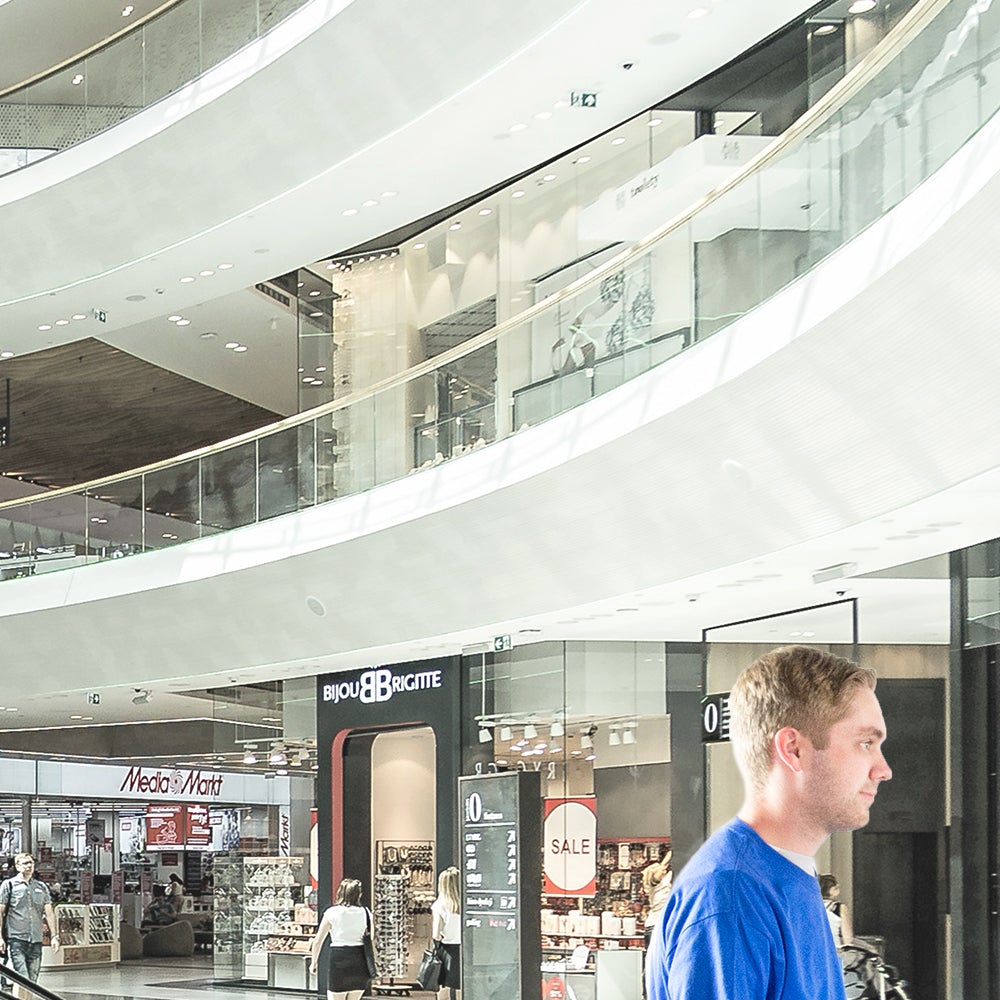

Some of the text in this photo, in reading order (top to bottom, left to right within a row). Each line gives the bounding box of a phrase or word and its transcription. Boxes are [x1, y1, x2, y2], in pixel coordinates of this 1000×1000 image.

[704, 703, 718, 733] 0
[120, 766, 223, 796] Media Markt
[551, 839, 590, 855] SALE
